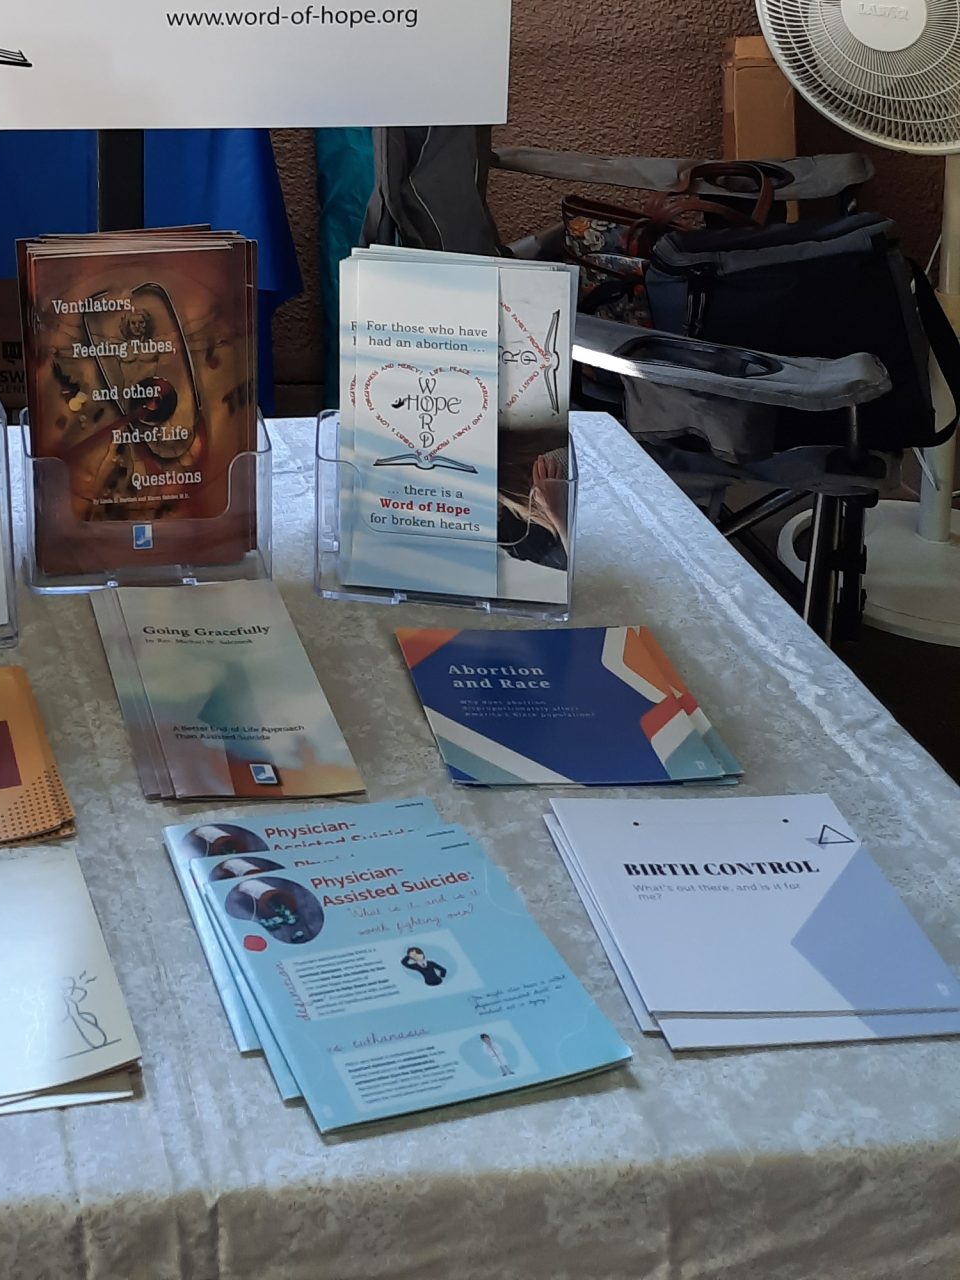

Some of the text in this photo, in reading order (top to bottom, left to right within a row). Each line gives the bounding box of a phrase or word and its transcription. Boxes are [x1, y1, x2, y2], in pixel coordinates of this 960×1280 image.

[166, 5, 418, 29] www.word-of-hope.org
[51, 296, 135, 314] Ventilators,
[366, 321, 488, 339] For those who have
[71, 338, 176, 360] Feeding Tubes,
[368, 334, 468, 352] had an abortion
[91, 383, 162, 403] and other
[110, 425, 189, 446] End-of-Life
[131, 469, 202, 489] Questions
[403, 484, 465, 500] there is a
[379, 497, 471, 517] Word of Hope
[370, 512, 481, 532] for broken hearts
[142, 625, 271, 638] Going Gracefully
[448, 664, 545, 676] Abortion
[452, 678, 551, 689] and Race
[263, 821, 357, 843] Physician-
[623, 860, 820, 876] BIRTH CONTROL
[310, 867, 408, 890] Physician-
[322, 871, 475, 908] Assisted Suicide:
